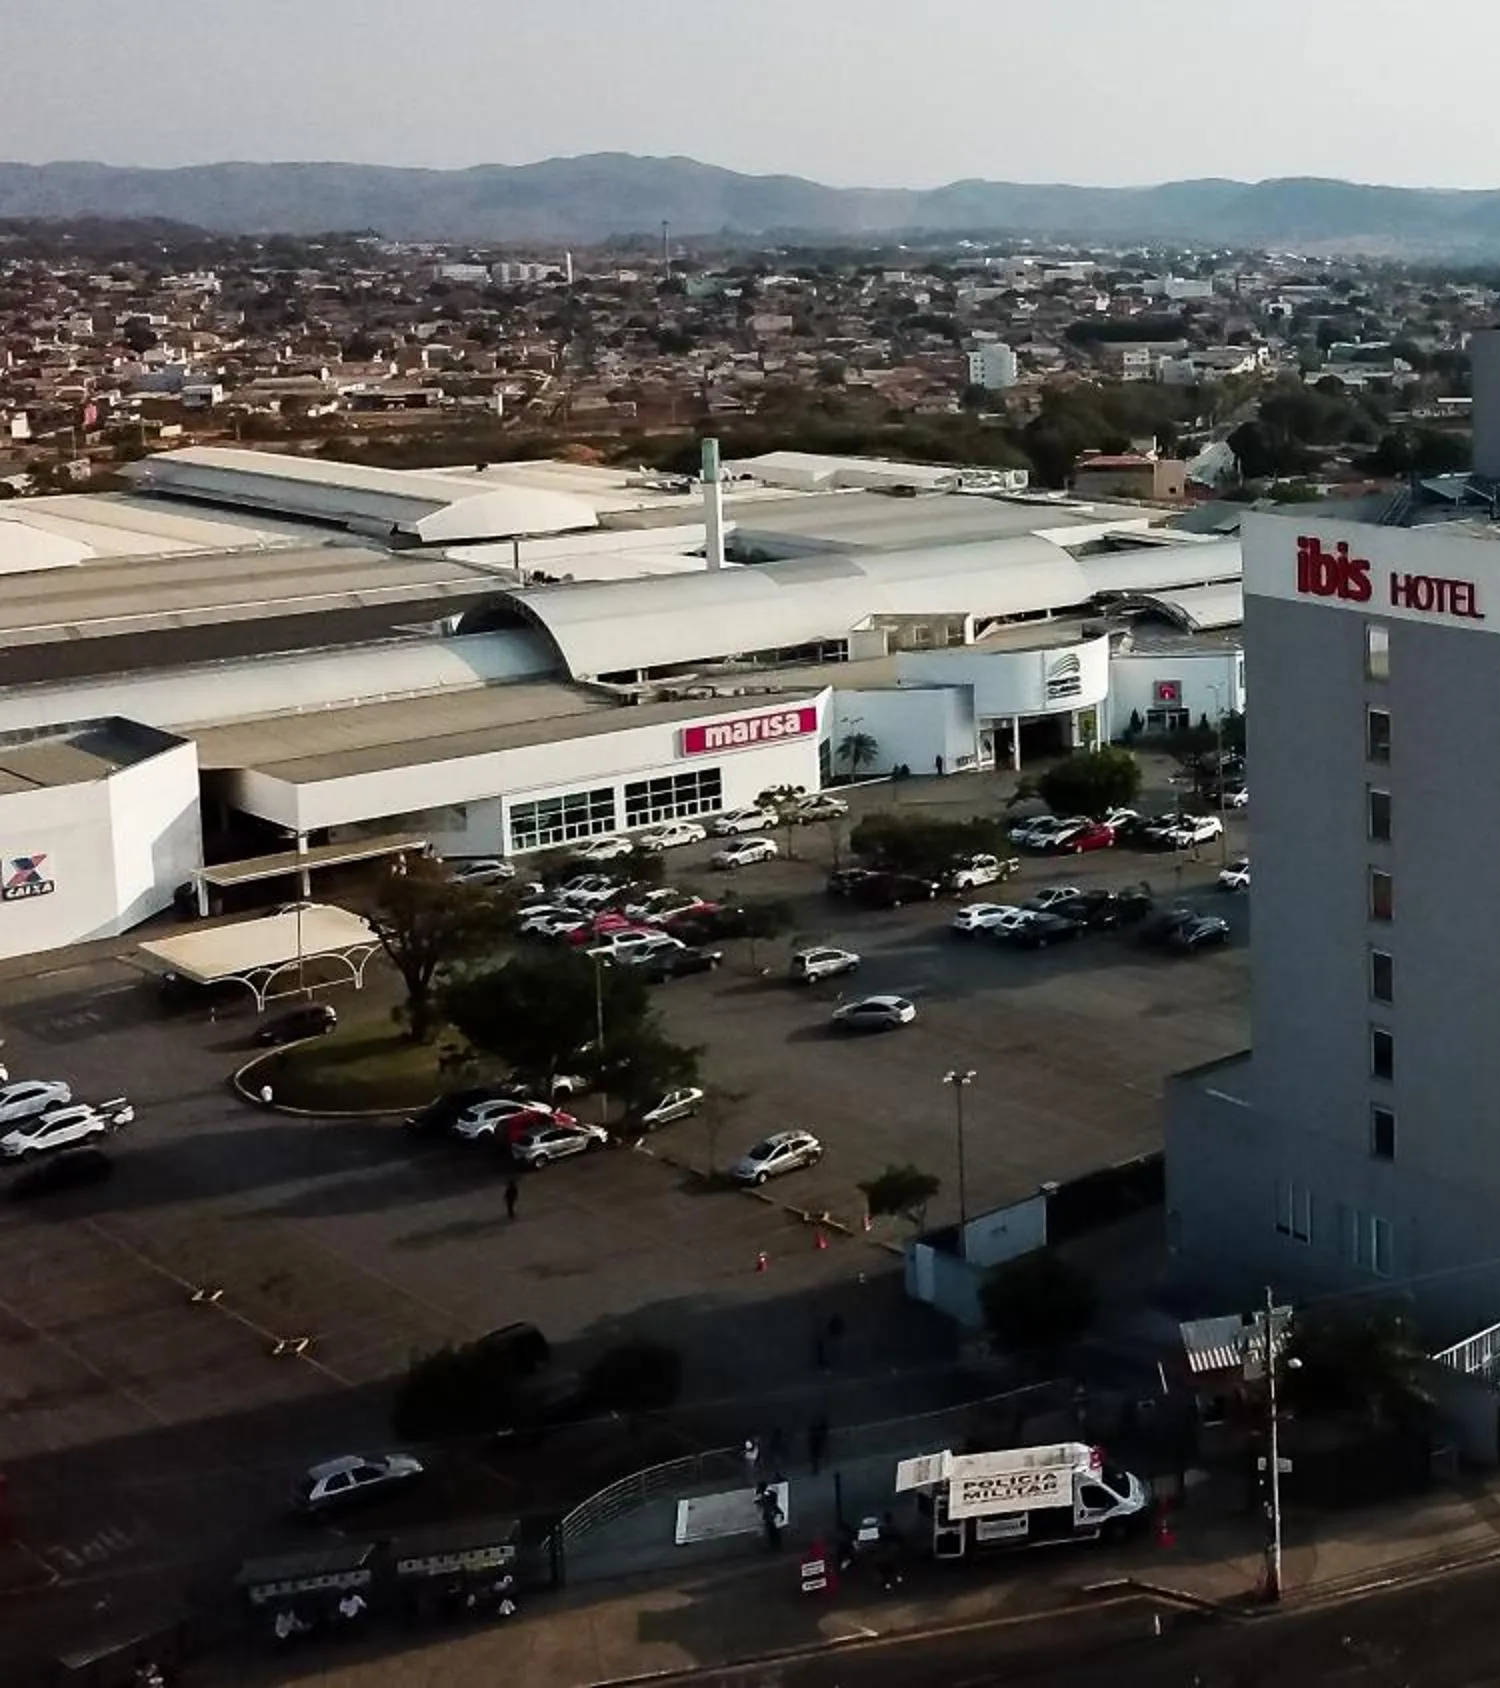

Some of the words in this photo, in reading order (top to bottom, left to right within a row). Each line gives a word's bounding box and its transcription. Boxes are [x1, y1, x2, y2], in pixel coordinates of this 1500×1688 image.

[1297, 536, 1372, 601] ibis
[1391, 572, 1485, 618] HOTEL
[705, 713, 801, 748] marisa
[5, 882, 53, 898] CAIXA
[963, 1482, 1057, 1501] MILITAR
